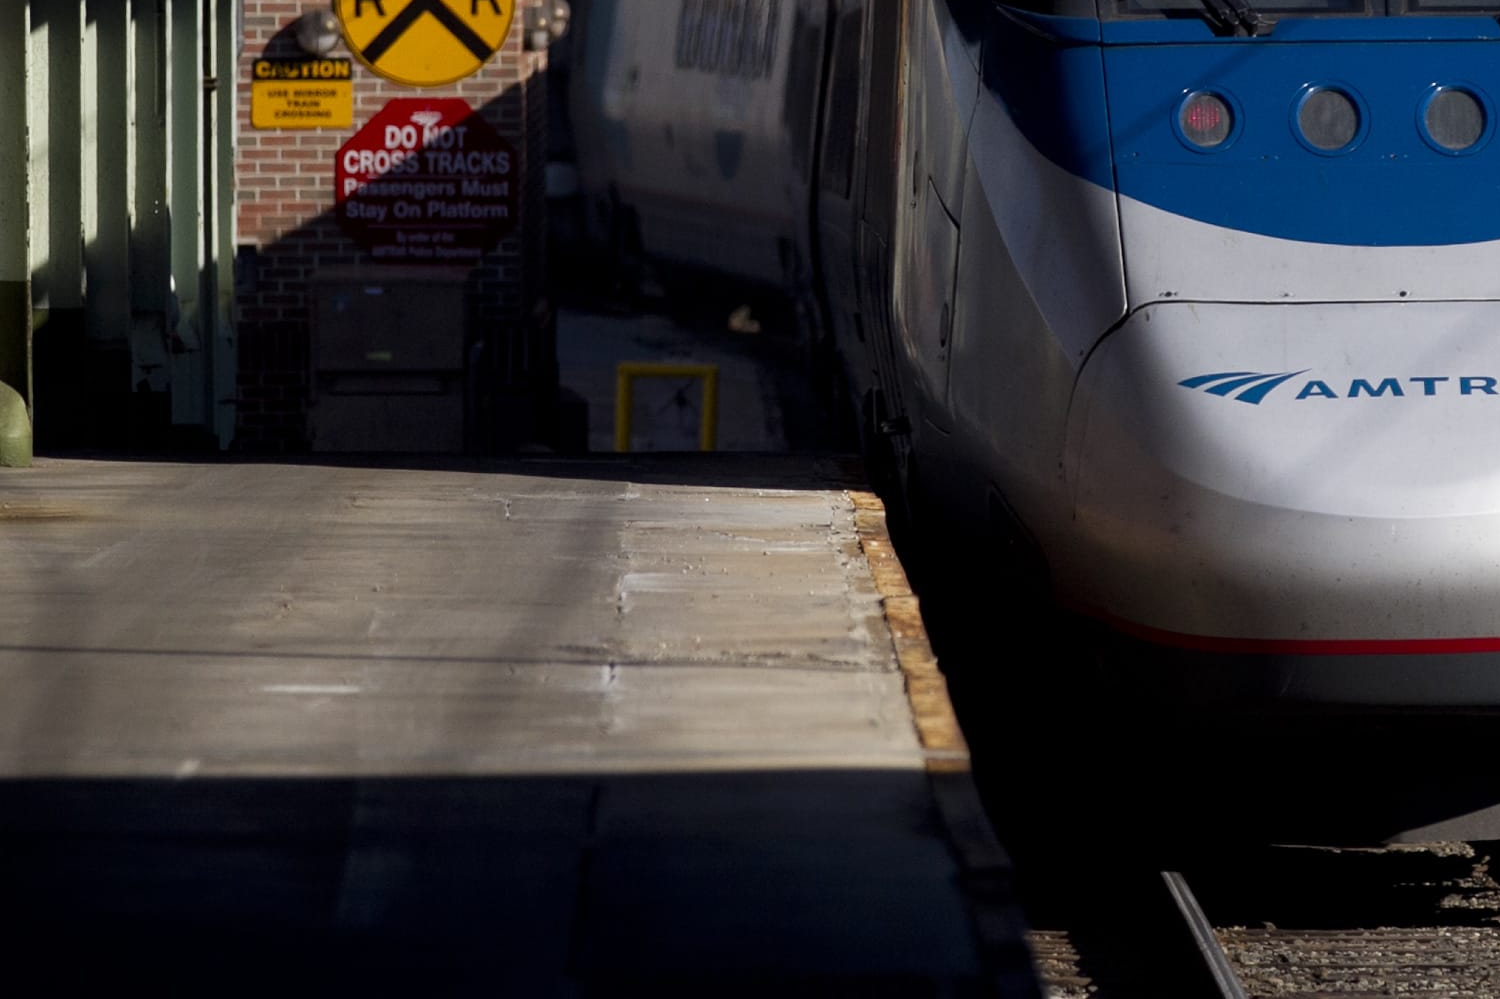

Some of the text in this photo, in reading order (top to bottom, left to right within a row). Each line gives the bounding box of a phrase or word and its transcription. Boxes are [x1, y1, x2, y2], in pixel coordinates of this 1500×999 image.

[256, 60, 349, 78] CAUTION
[385, 125, 467, 149] DO NOT
[343, 150, 510, 174] CROSS TRACKS
[344, 178, 509, 200] Passengers Must
[346, 201, 509, 222] Stay On Platform
